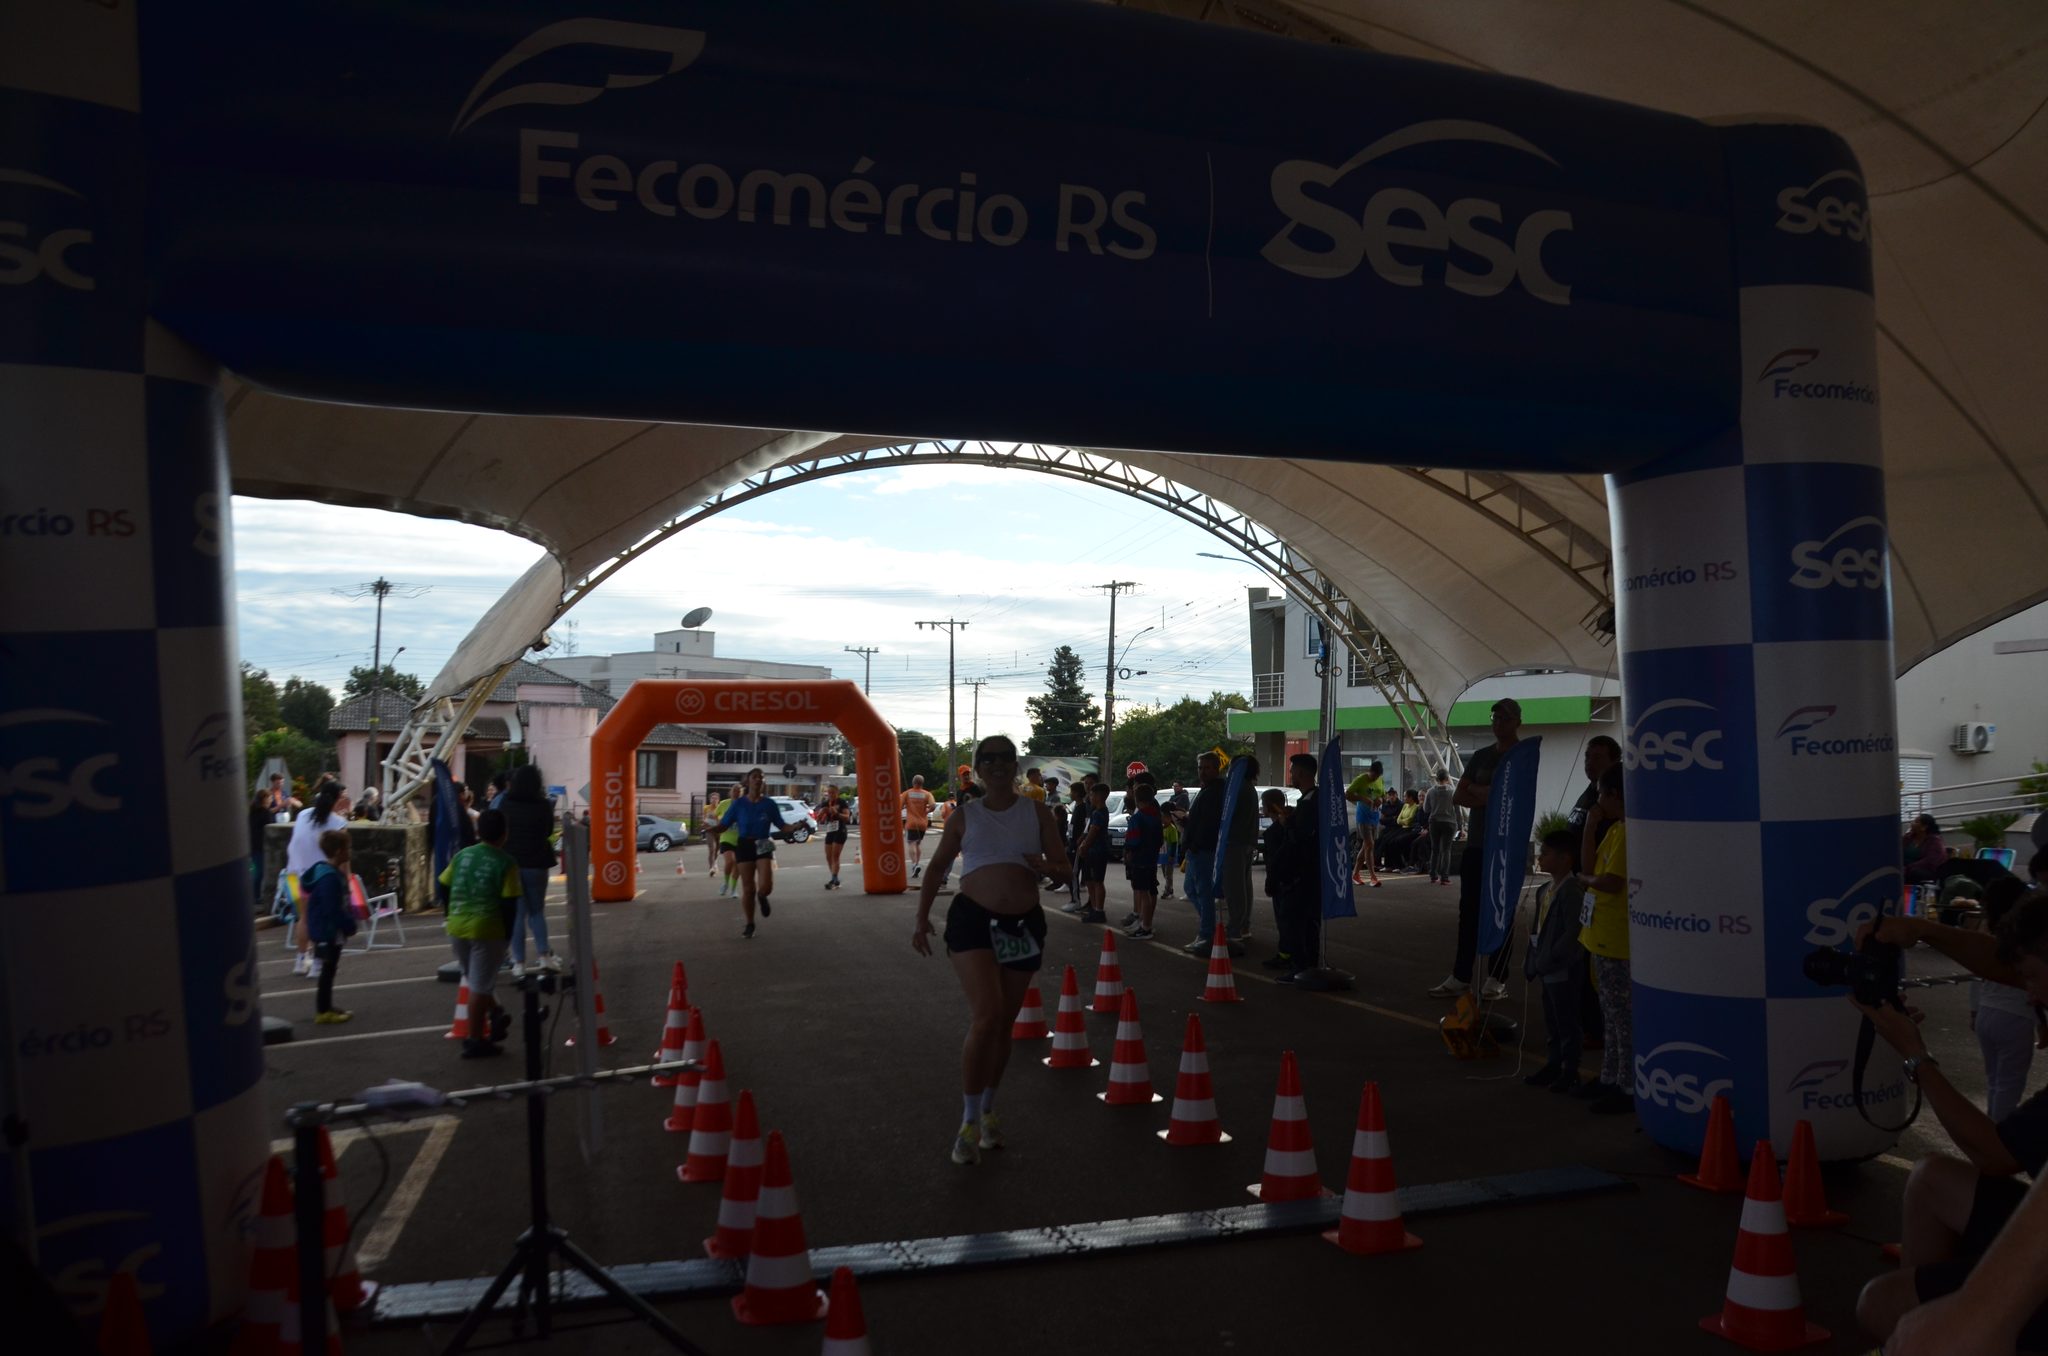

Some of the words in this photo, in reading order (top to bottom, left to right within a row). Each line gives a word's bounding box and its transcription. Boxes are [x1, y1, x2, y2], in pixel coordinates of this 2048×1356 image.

[517, 127, 1029, 247] Fecomércio
[1055, 183, 1158, 261] RS
[1259, 157, 1574, 307] Sesc
[86, 507, 137, 537] RS
[1704, 560, 1737, 583] RS
[714, 690, 820, 712] CRESOL
[605, 765, 624, 854] CRESOL
[875, 758, 892, 845] CRESOL
[1332, 836, 1348, 900] Sesc
[1628, 910, 1712, 934] ecomércio
[1718, 914, 1753, 936] RS
[995, 935, 1032, 960] 290
